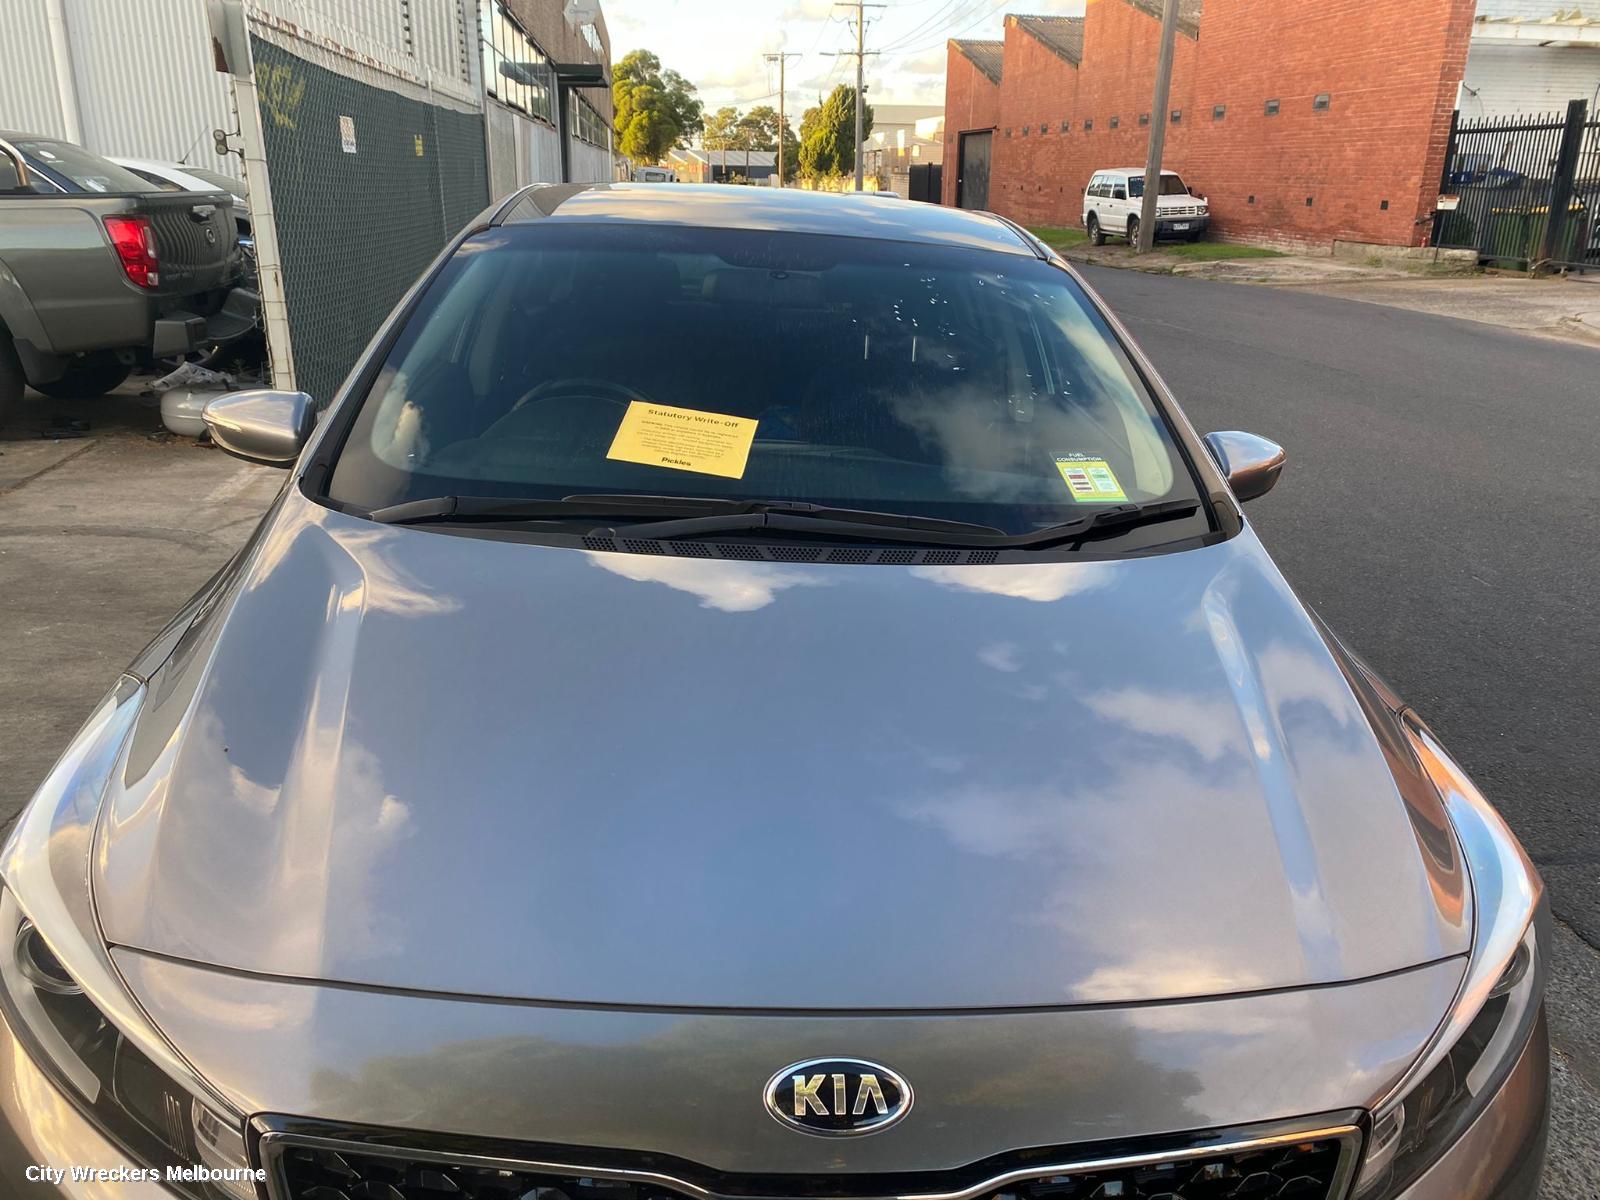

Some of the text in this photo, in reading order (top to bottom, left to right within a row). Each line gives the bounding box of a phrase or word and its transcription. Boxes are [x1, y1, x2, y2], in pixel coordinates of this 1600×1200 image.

[648, 409, 740, 428] Statutory Write-Off
[661, 457, 691, 466] Pickles
[792, 1073, 889, 1116] KIA
